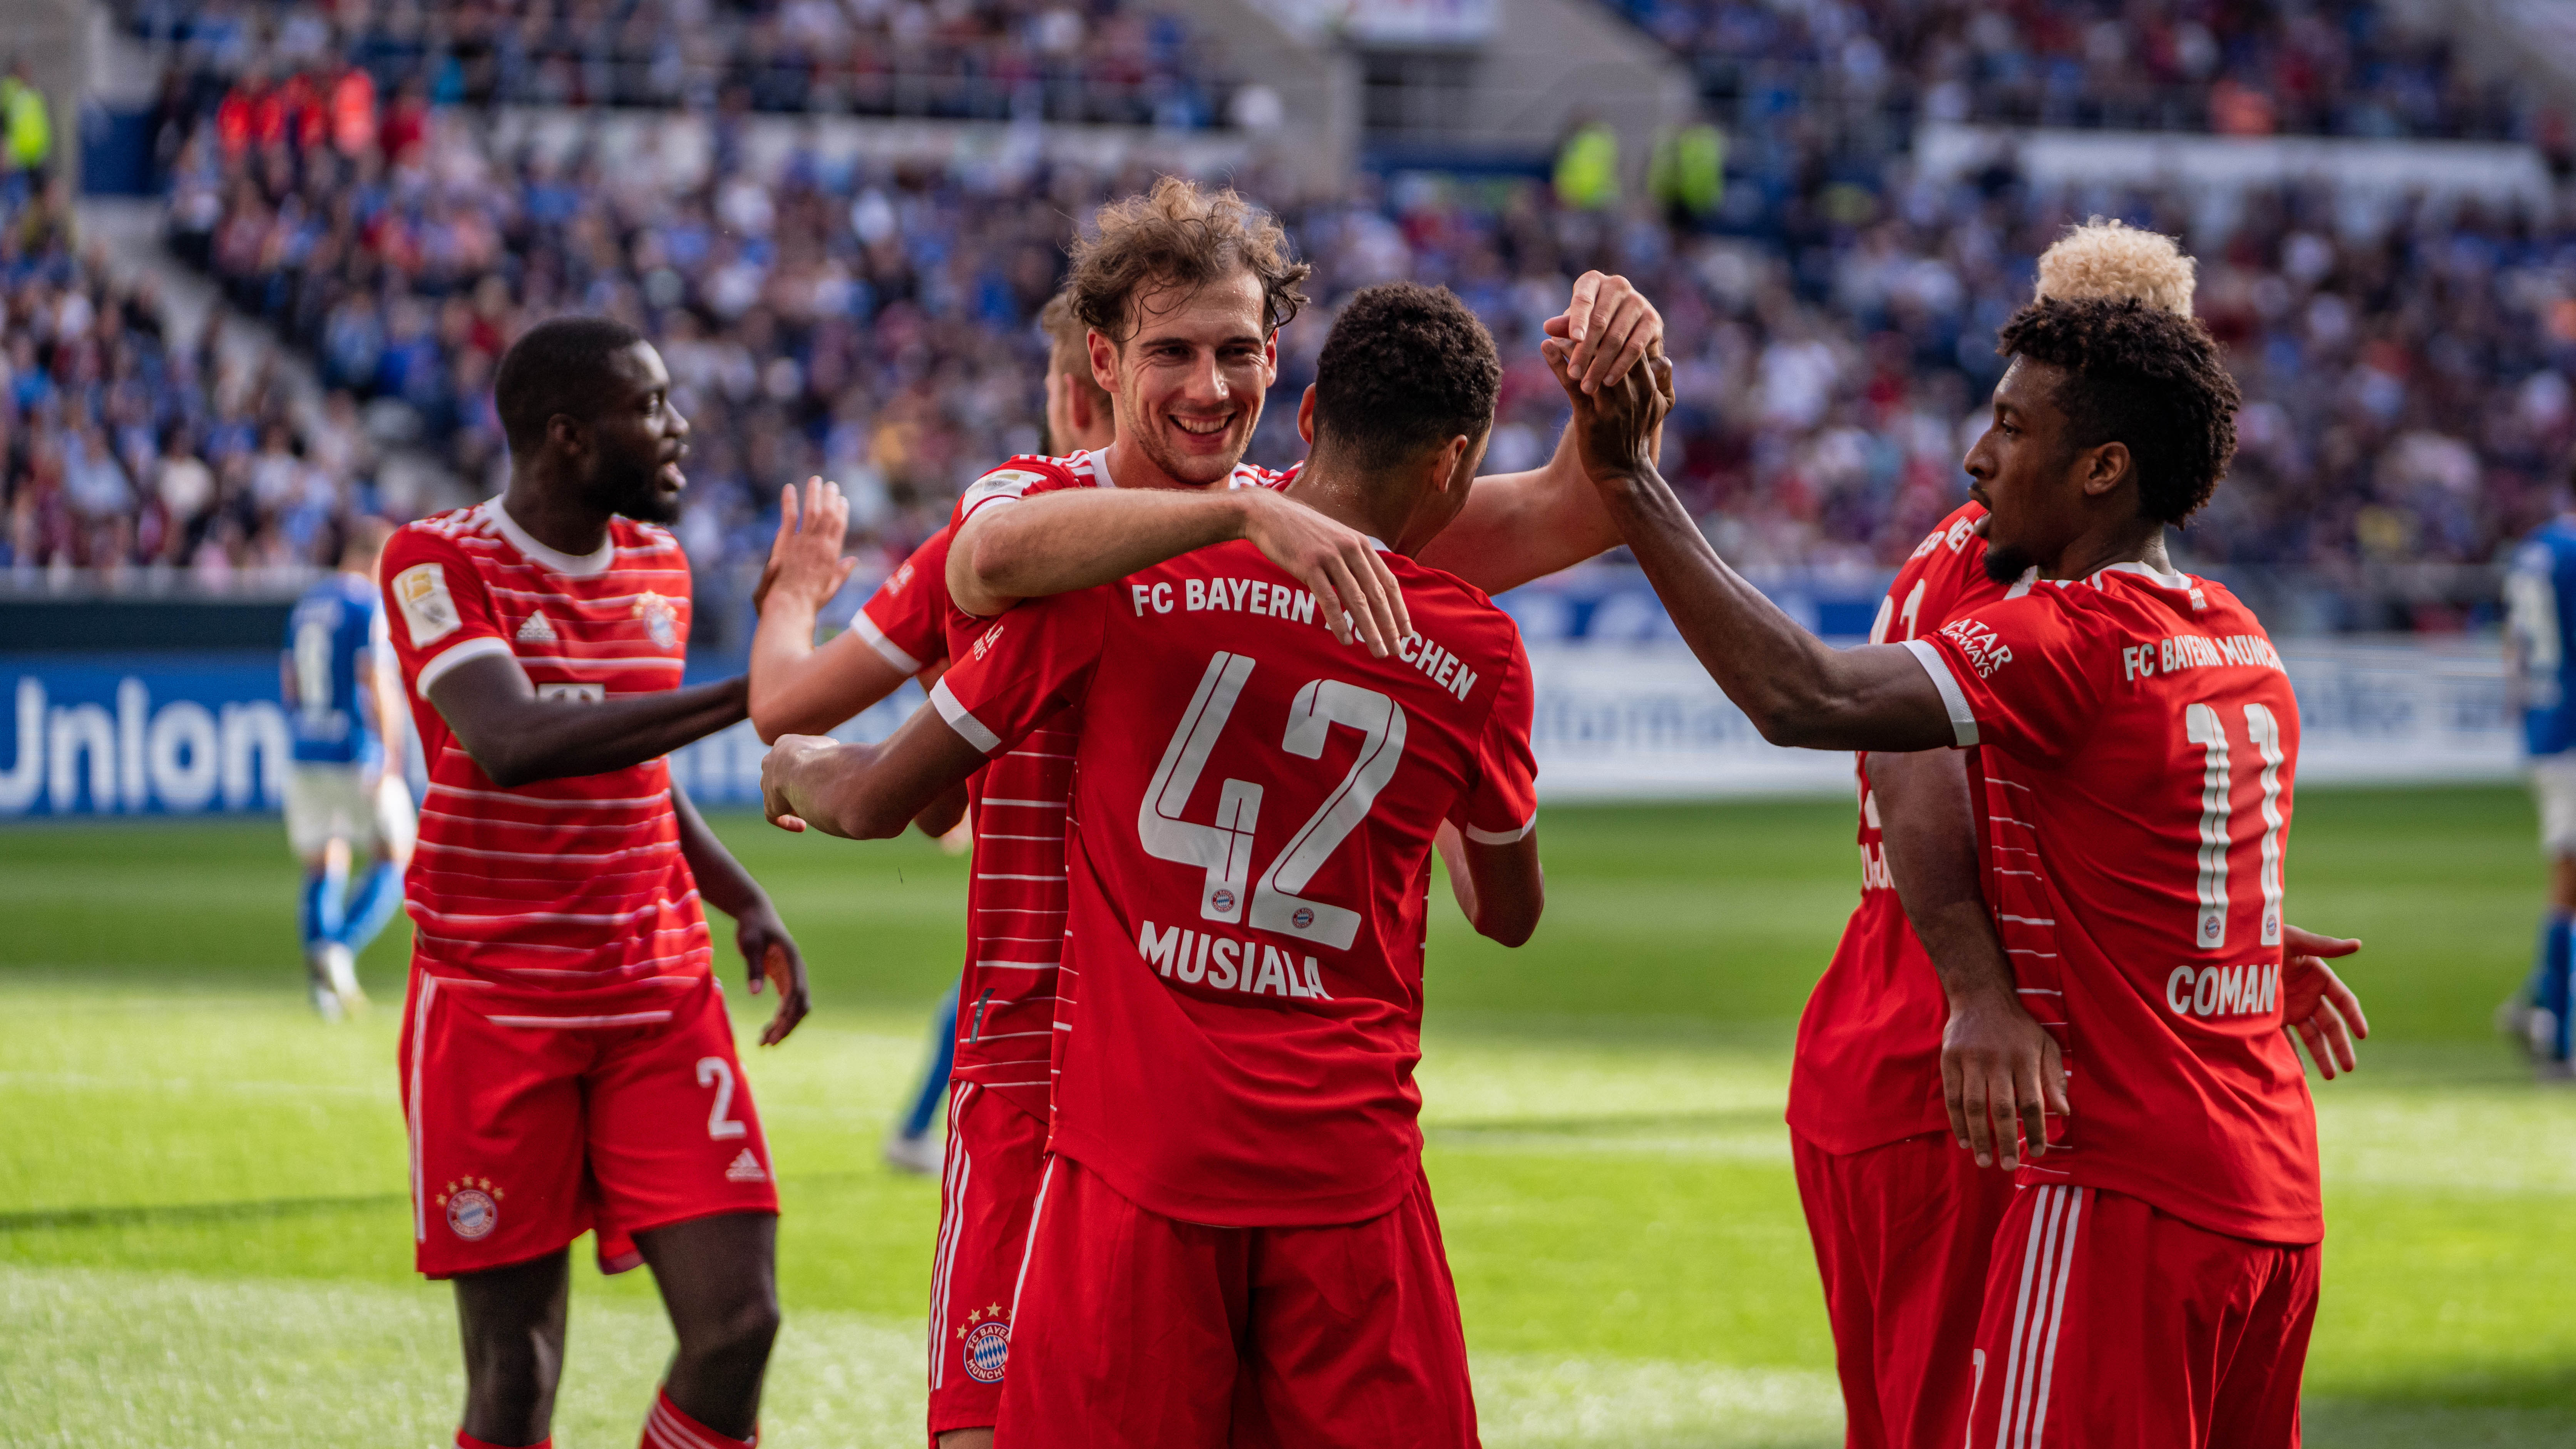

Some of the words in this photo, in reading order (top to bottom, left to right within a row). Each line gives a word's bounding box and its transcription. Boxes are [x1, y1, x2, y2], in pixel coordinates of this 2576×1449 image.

[1132, 582, 1173, 617] FC
[1186, 578, 1316, 624] BAYERN
[1324, 609, 1478, 702] CHEN
[2123, 643, 2155, 681] FC
[2162, 635, 2223, 673] BAYERN
[1138, 650, 1407, 951] 42
[2185, 702, 2284, 949] 11
[1138, 920, 1334, 1001] MUSIALA
[2166, 964, 2279, 1016] COMAN
[696, 1055, 747, 1140] 2
[968, 1335, 979, 1350] FC
